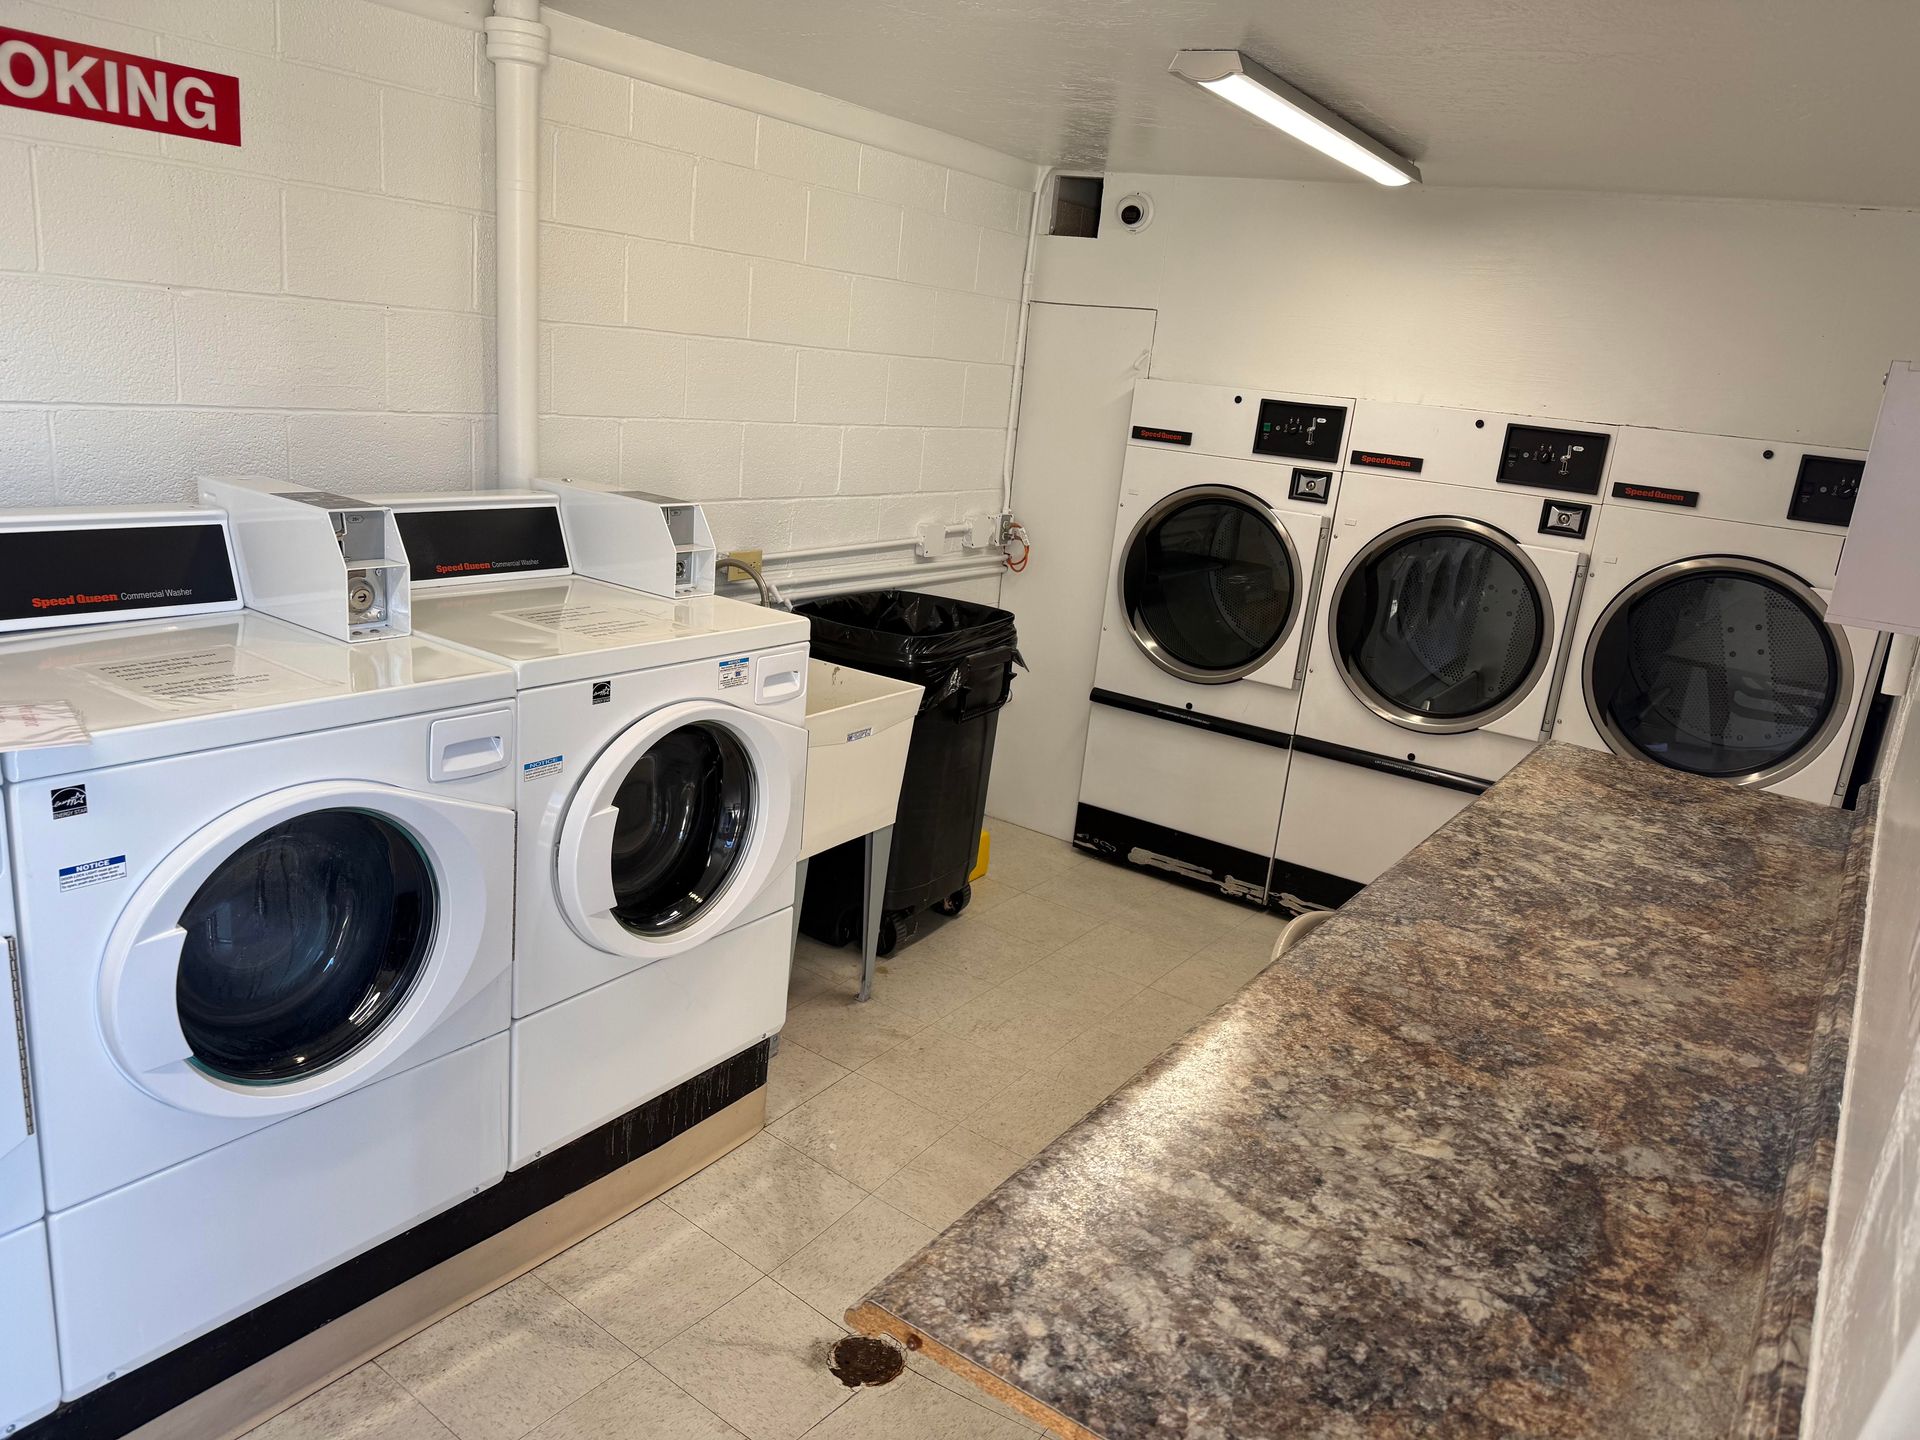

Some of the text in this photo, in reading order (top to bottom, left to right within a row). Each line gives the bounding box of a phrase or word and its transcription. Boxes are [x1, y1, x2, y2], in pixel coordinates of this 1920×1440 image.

[0, 40, 216, 131] OKING
[1361, 455, 1411, 466] Speed Queen
[1625, 487, 1684, 500] Speed Queen
[436, 564, 464, 573] Speed
[464, 562, 490, 570] Queen
[492, 560, 520, 568] Commercial
[32, 588, 193, 608] Speed Queen Commercial Washer
[530, 758, 558, 768] NOTICE
[76, 860, 110, 872] NOTICE
